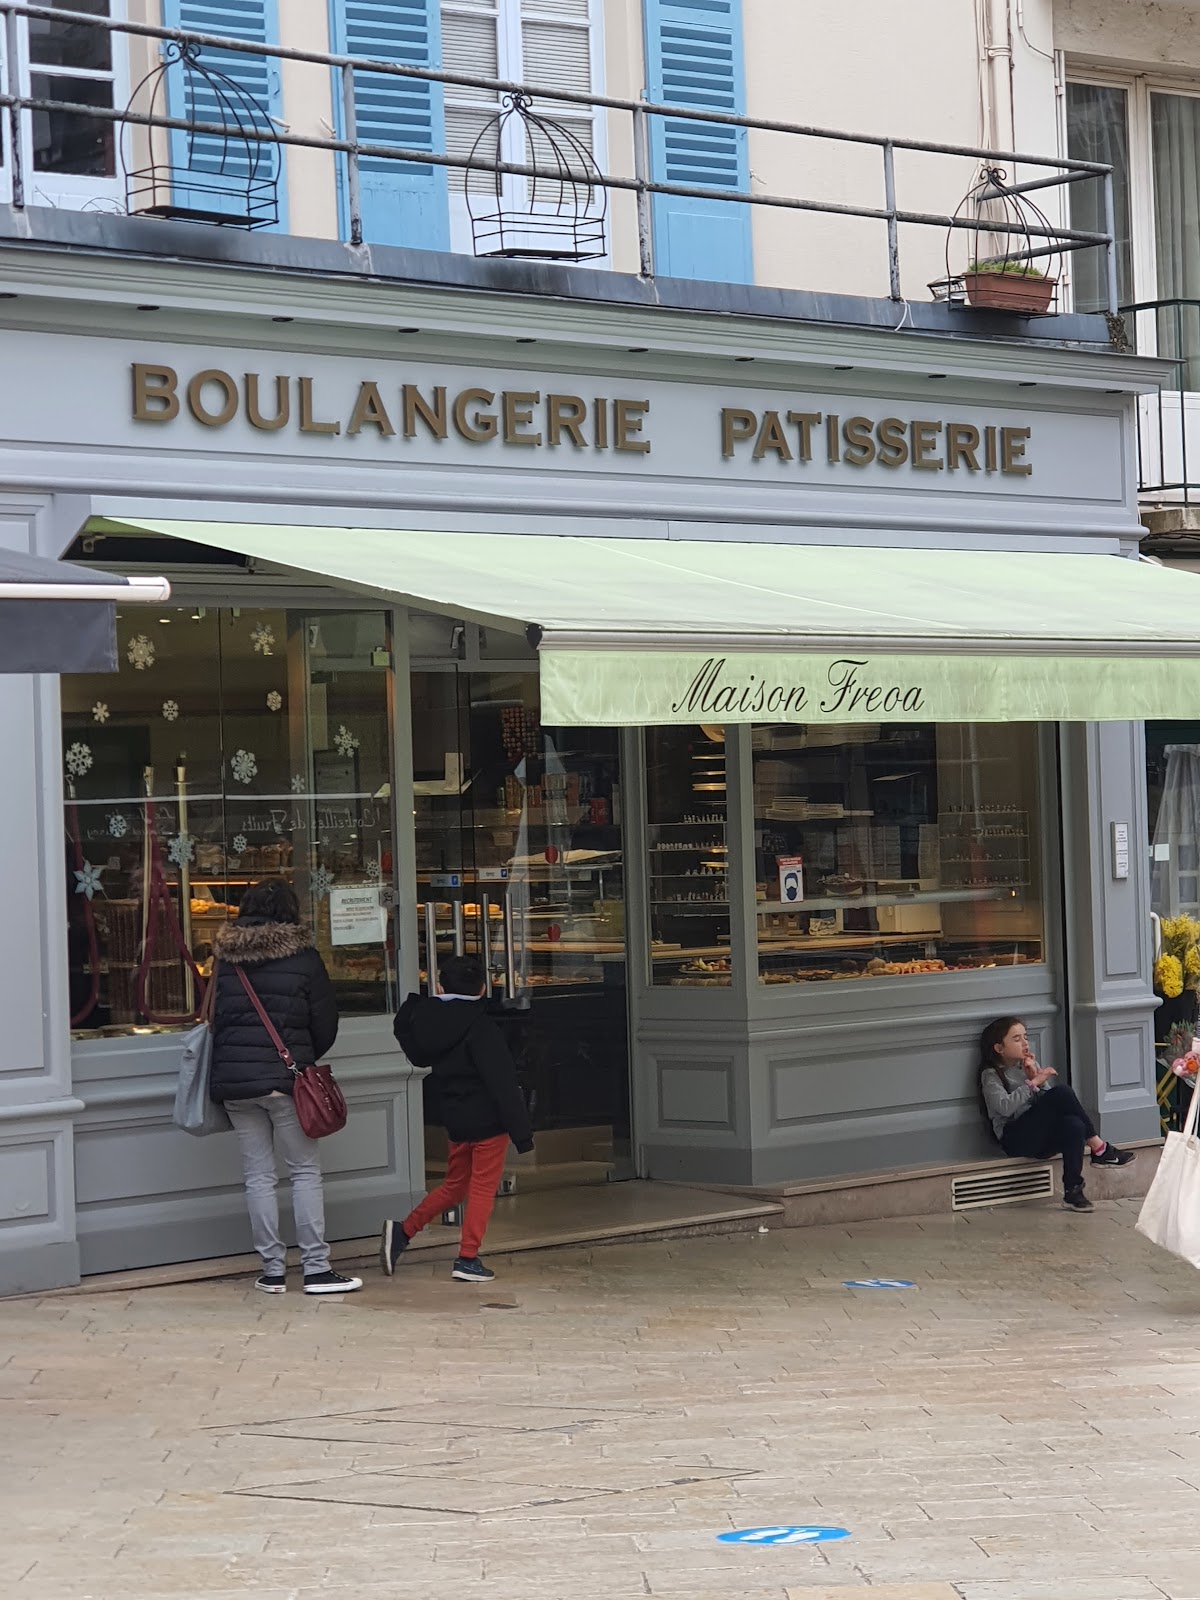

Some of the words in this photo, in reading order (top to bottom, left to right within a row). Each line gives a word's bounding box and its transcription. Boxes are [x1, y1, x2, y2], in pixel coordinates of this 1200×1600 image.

[132, 363, 651, 454] BOULANGERIE
[721, 407, 1033, 476] PATISSERIE
[672, 657, 808, 713] Maison
